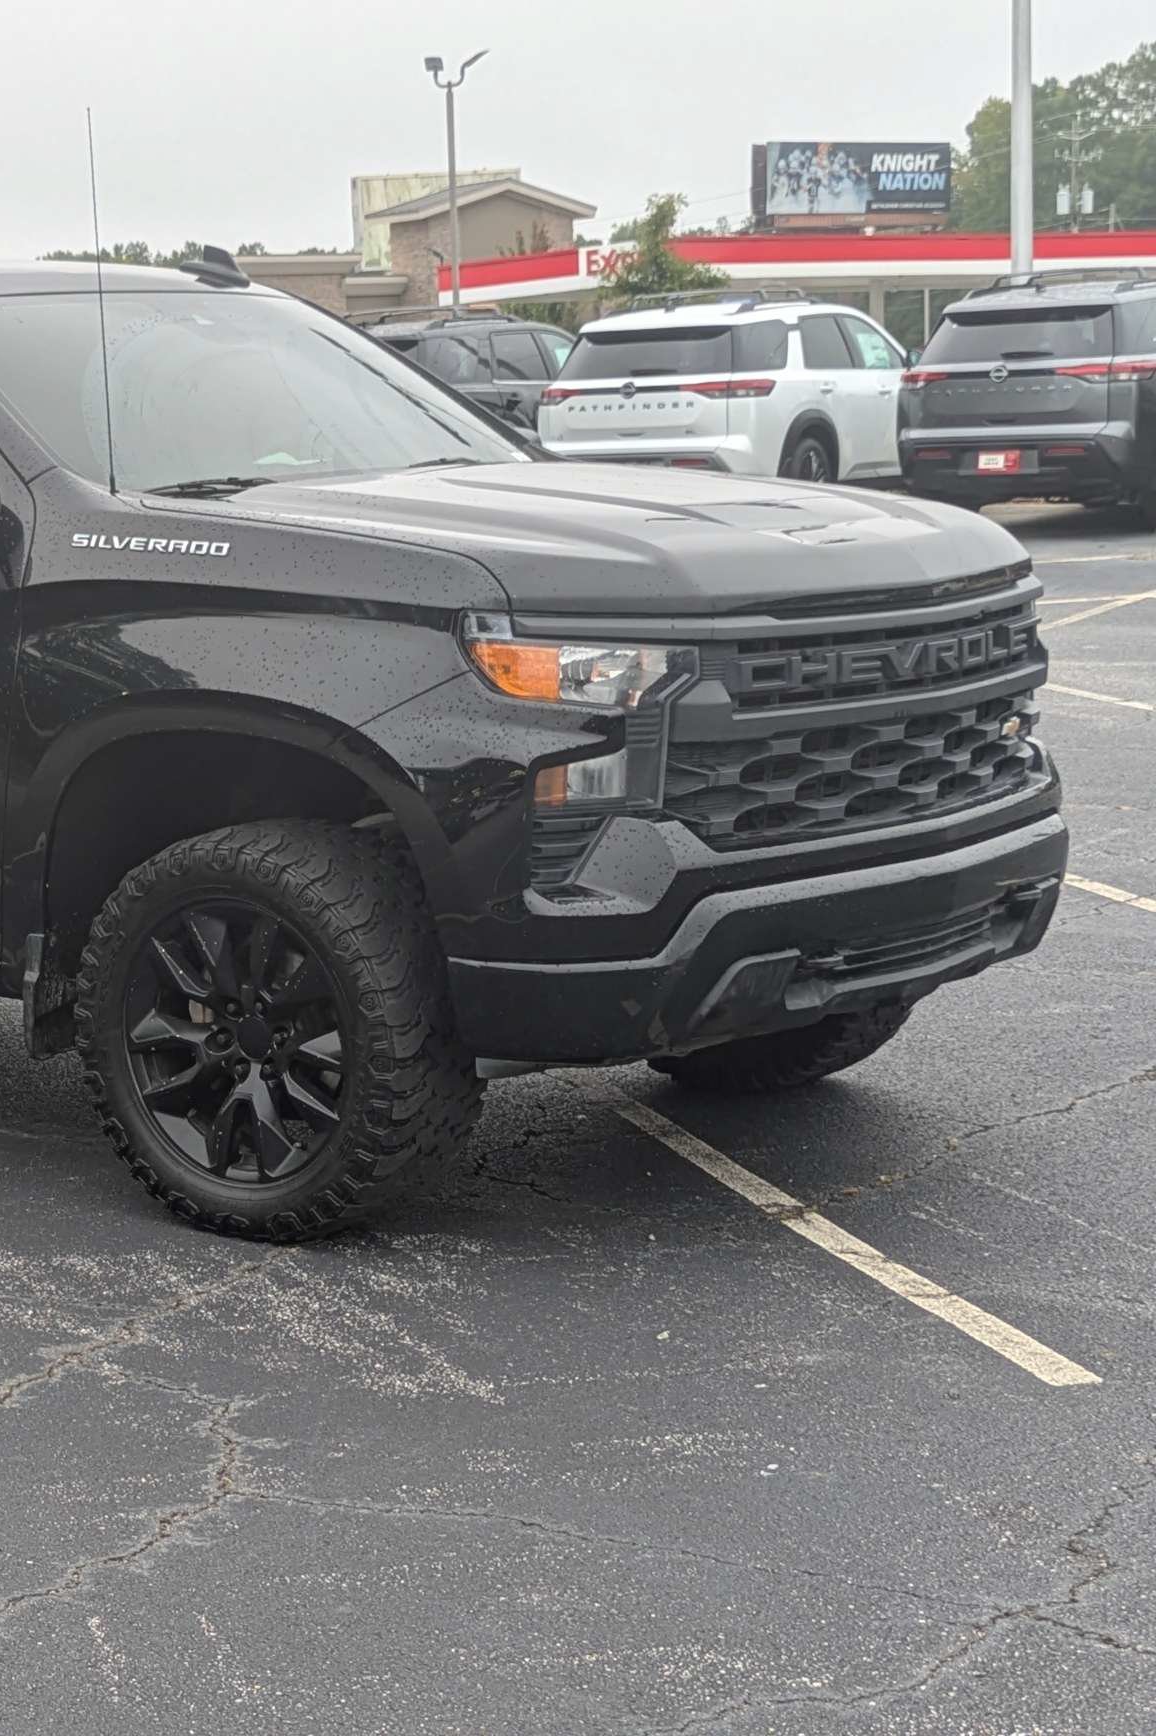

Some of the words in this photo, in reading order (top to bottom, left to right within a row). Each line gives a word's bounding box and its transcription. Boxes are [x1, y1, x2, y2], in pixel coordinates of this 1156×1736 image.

[871, 152, 940, 172] KNIGHT
[878, 172, 946, 191] NATION
[568, 402, 694, 413] PATHFINDER
[71, 533, 231, 556] SILVERADO
